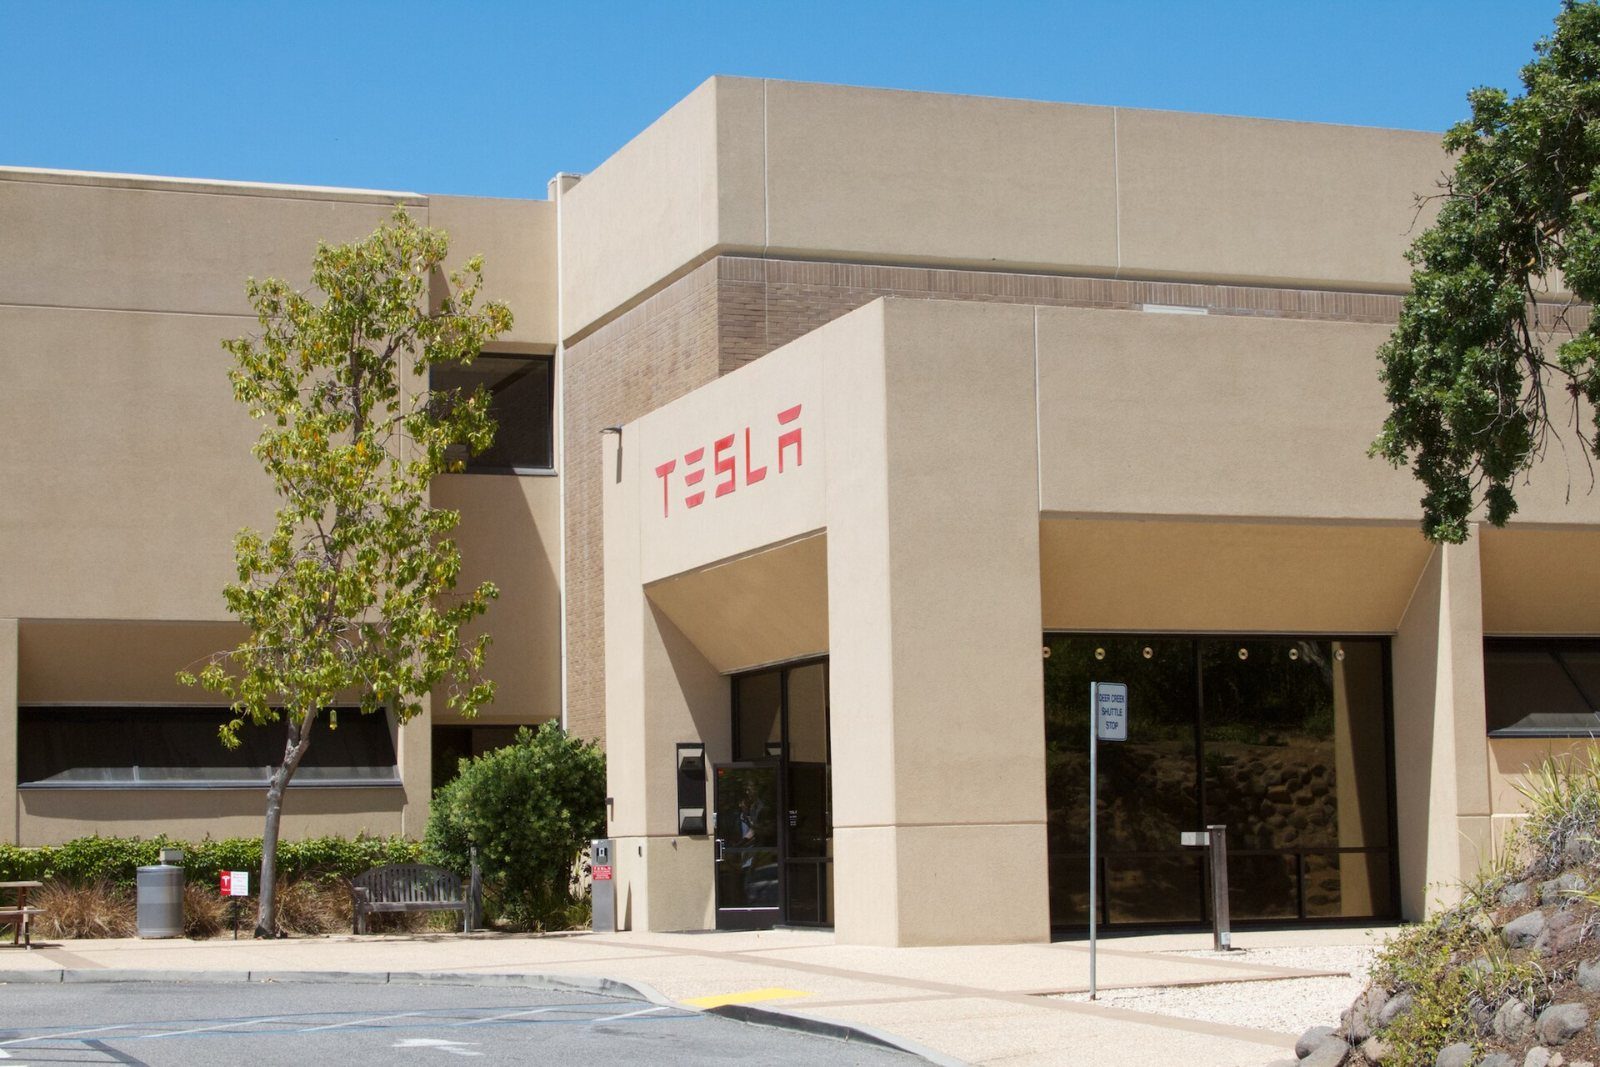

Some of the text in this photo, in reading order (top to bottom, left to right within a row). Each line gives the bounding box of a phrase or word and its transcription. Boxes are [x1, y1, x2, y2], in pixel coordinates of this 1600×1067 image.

[655, 403, 802, 518] TESLA
[1099, 694, 1124, 703] DEER CREEK
[1102, 707, 1122, 716] SHUTTLE
[1105, 721, 1119, 730] STOP
